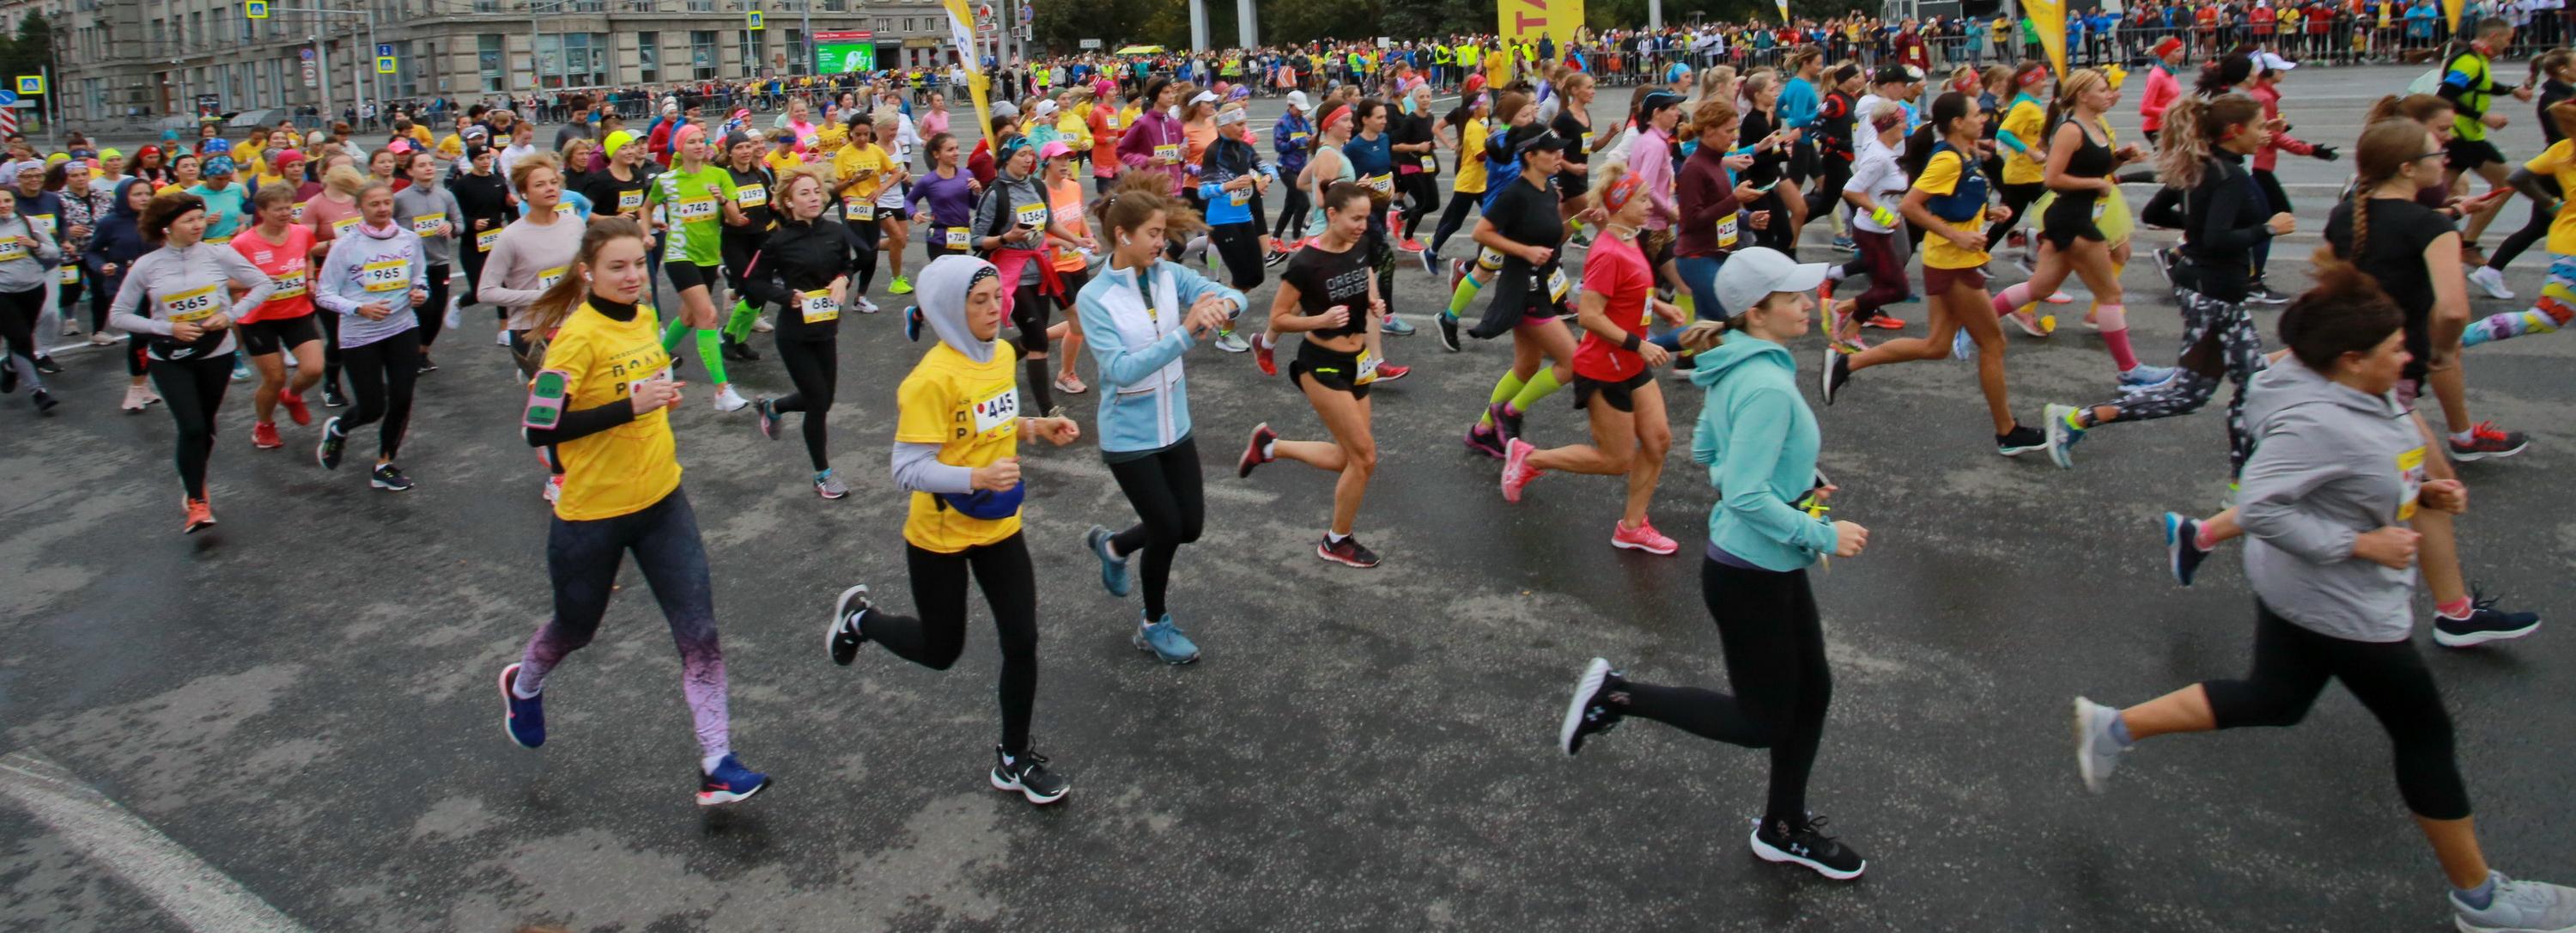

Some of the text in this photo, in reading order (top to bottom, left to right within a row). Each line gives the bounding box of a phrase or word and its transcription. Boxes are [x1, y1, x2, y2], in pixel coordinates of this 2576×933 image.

[689, 203, 709, 213] 742
[374, 267, 399, 280] 965
[175, 296, 208, 310] 365
[988, 393, 1013, 418] 445
